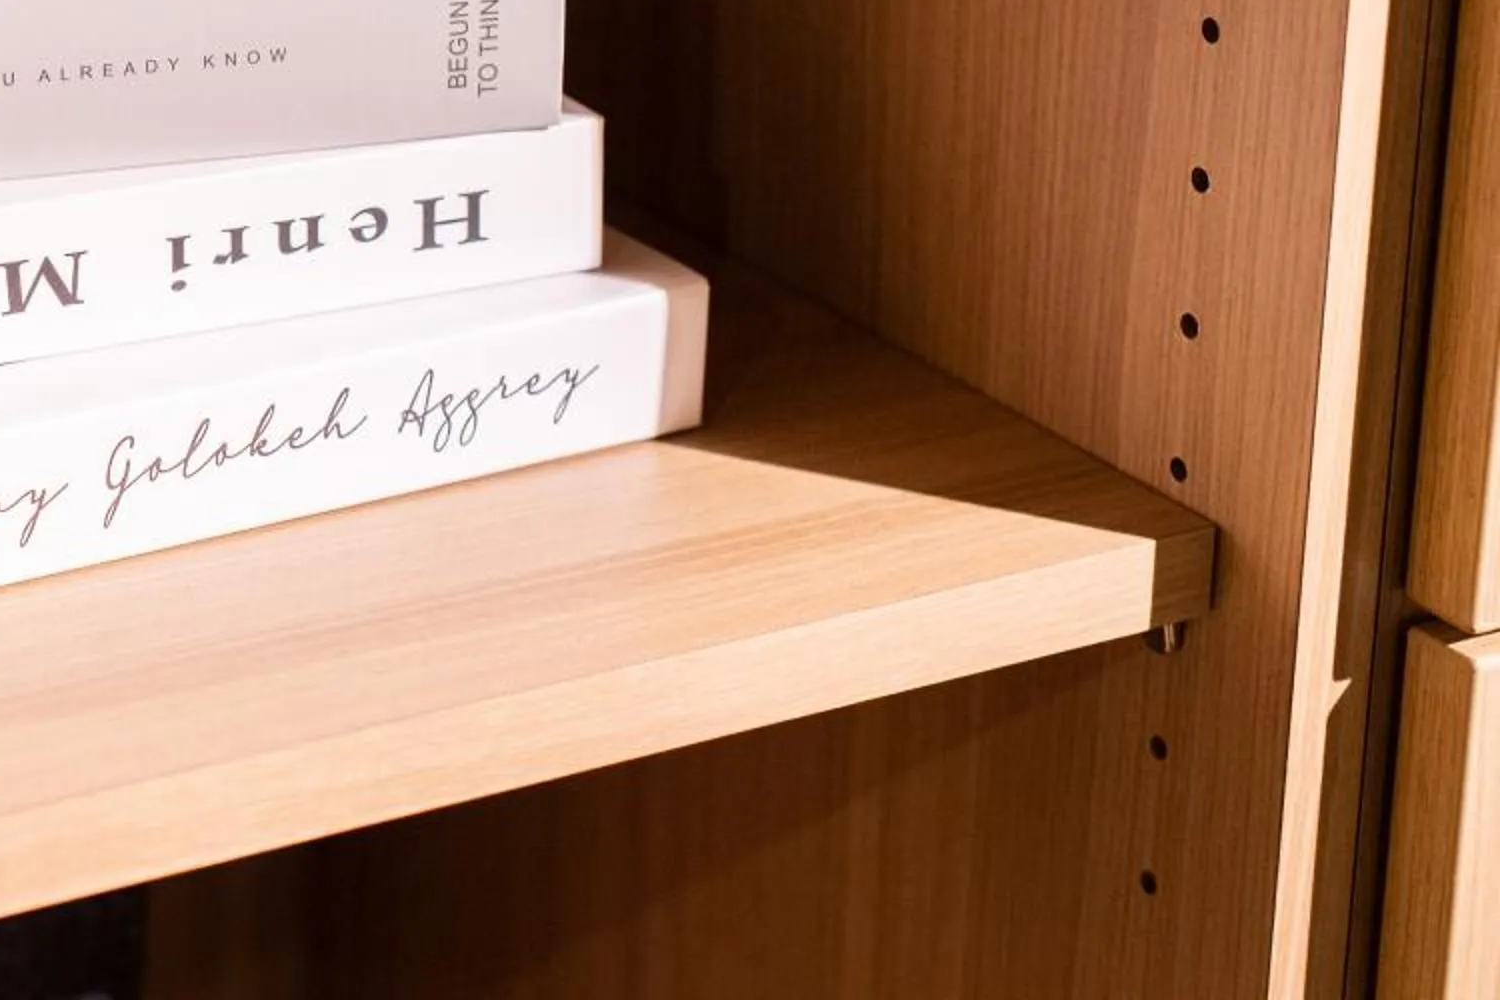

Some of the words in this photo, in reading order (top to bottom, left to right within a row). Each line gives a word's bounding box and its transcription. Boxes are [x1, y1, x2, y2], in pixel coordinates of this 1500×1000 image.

[36, 56, 181, 83] ALREADY
[202, 46, 288, 70] KNOW
[447, 0, 469, 89] BEGUN
[477, 62, 499, 98] TO
[165, 189, 490, 293] Henri
[103, 386, 368, 529] Golokeh
[397, 364, 600, 455] Aggrey
